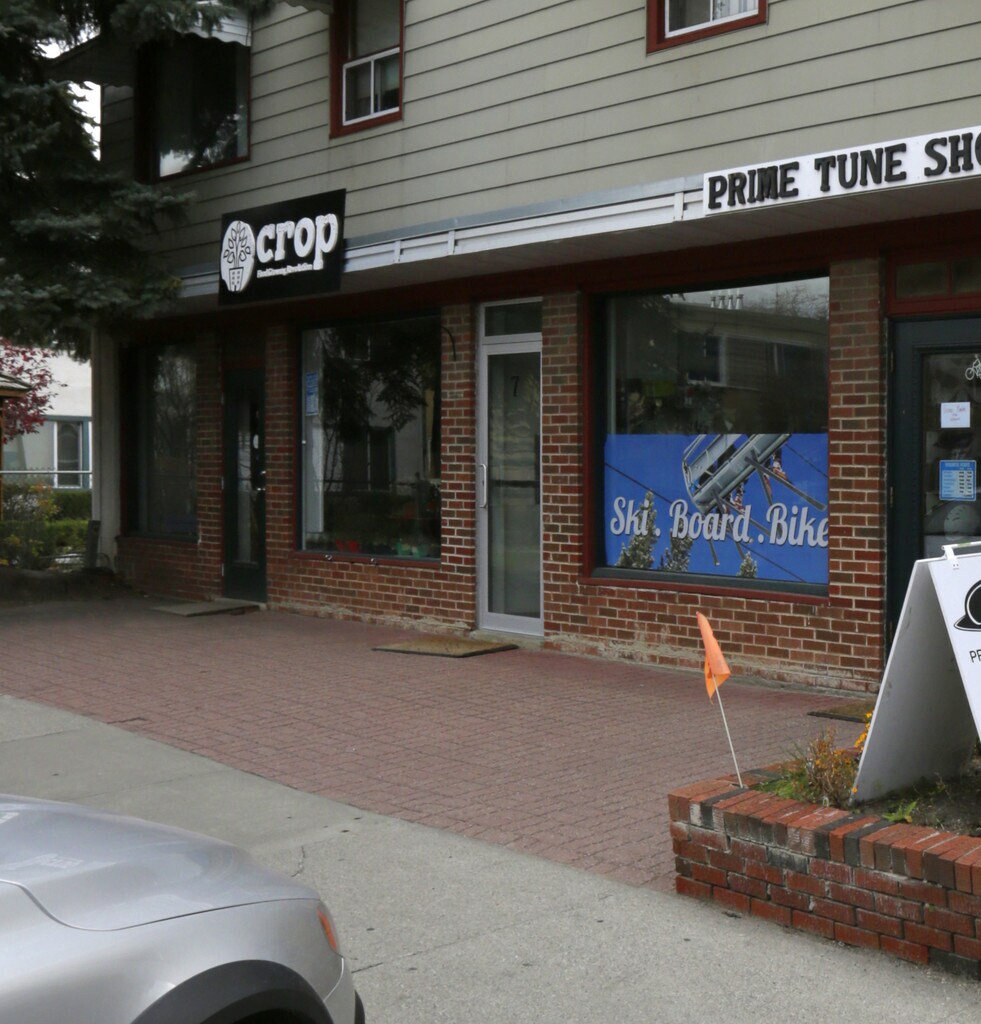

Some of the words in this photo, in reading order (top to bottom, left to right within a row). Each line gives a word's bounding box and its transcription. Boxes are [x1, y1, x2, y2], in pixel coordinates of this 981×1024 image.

[708, 161, 800, 210] PRIME
[814, 142, 907, 193] TUNE
[257, 214, 338, 270] crop
